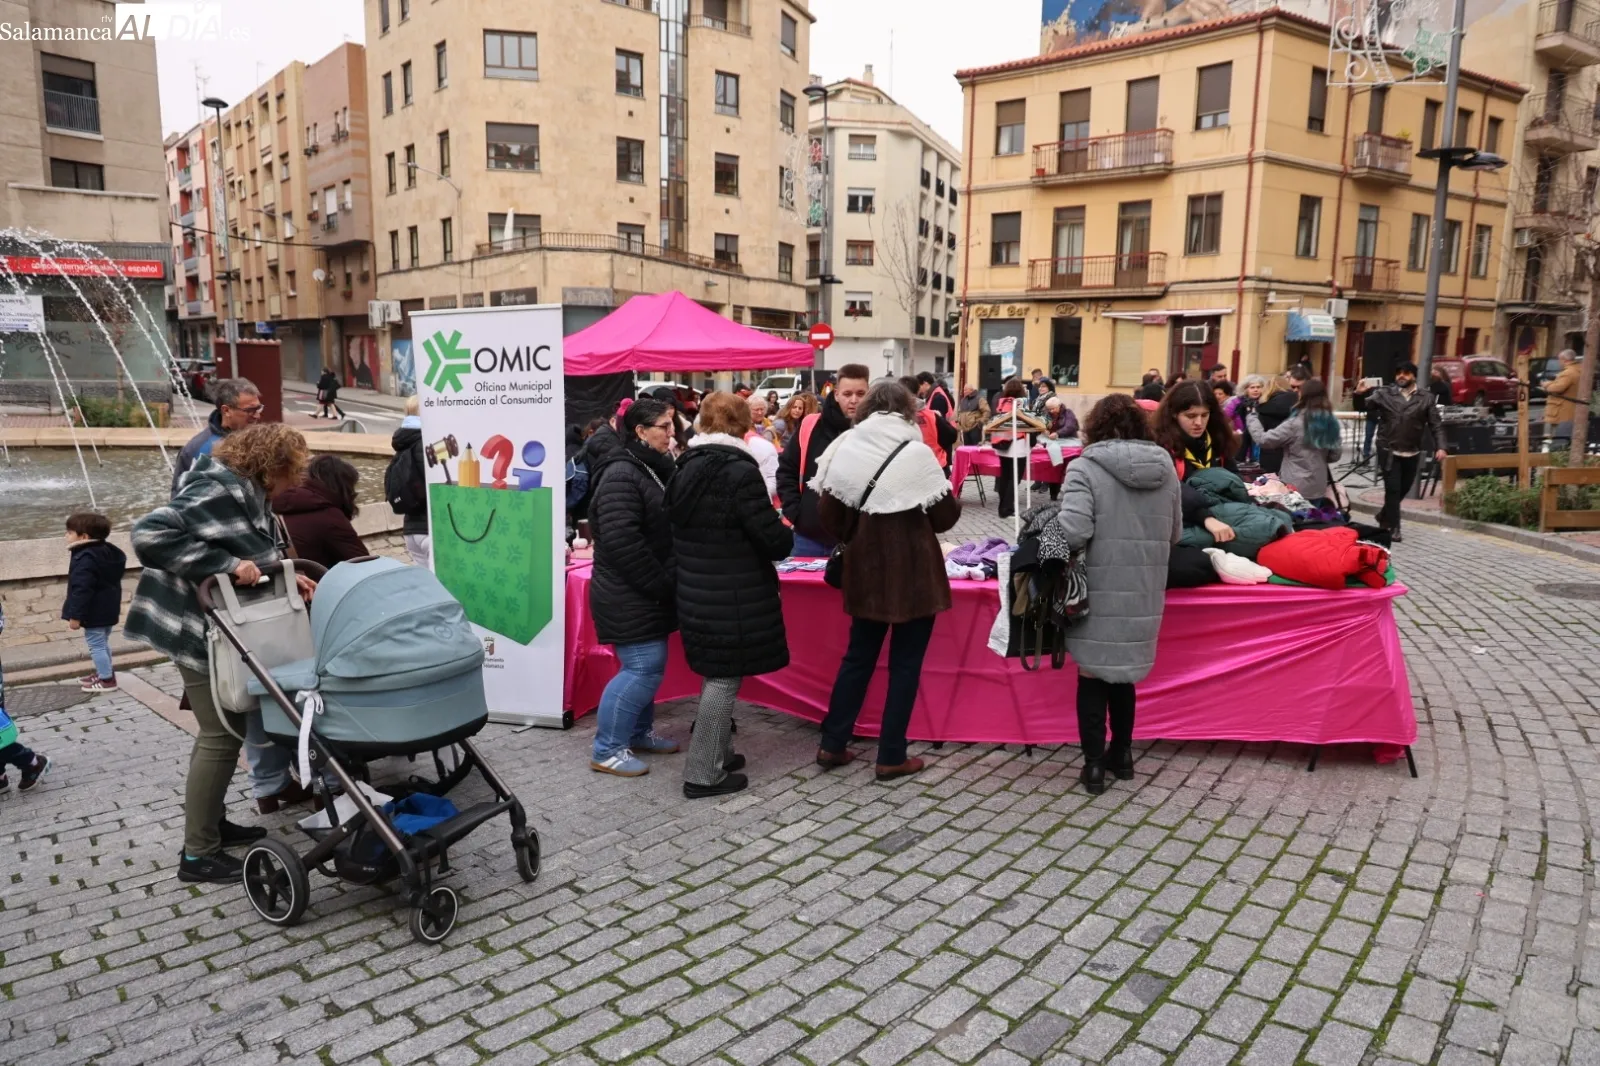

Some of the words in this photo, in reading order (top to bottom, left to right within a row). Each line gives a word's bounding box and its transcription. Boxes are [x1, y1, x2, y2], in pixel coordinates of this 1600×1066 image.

[127, 264, 158, 275] español
[1006, 305, 1030, 317] Bar
[474, 345, 551, 373] OMIC
[474, 380, 507, 392] Oficina
[508, 379, 552, 394] Municipal
[424, 396, 434, 407] de
[436, 395, 487, 407] Información
[489, 395, 498, 405] al
[500, 393, 553, 405] Consumidor
